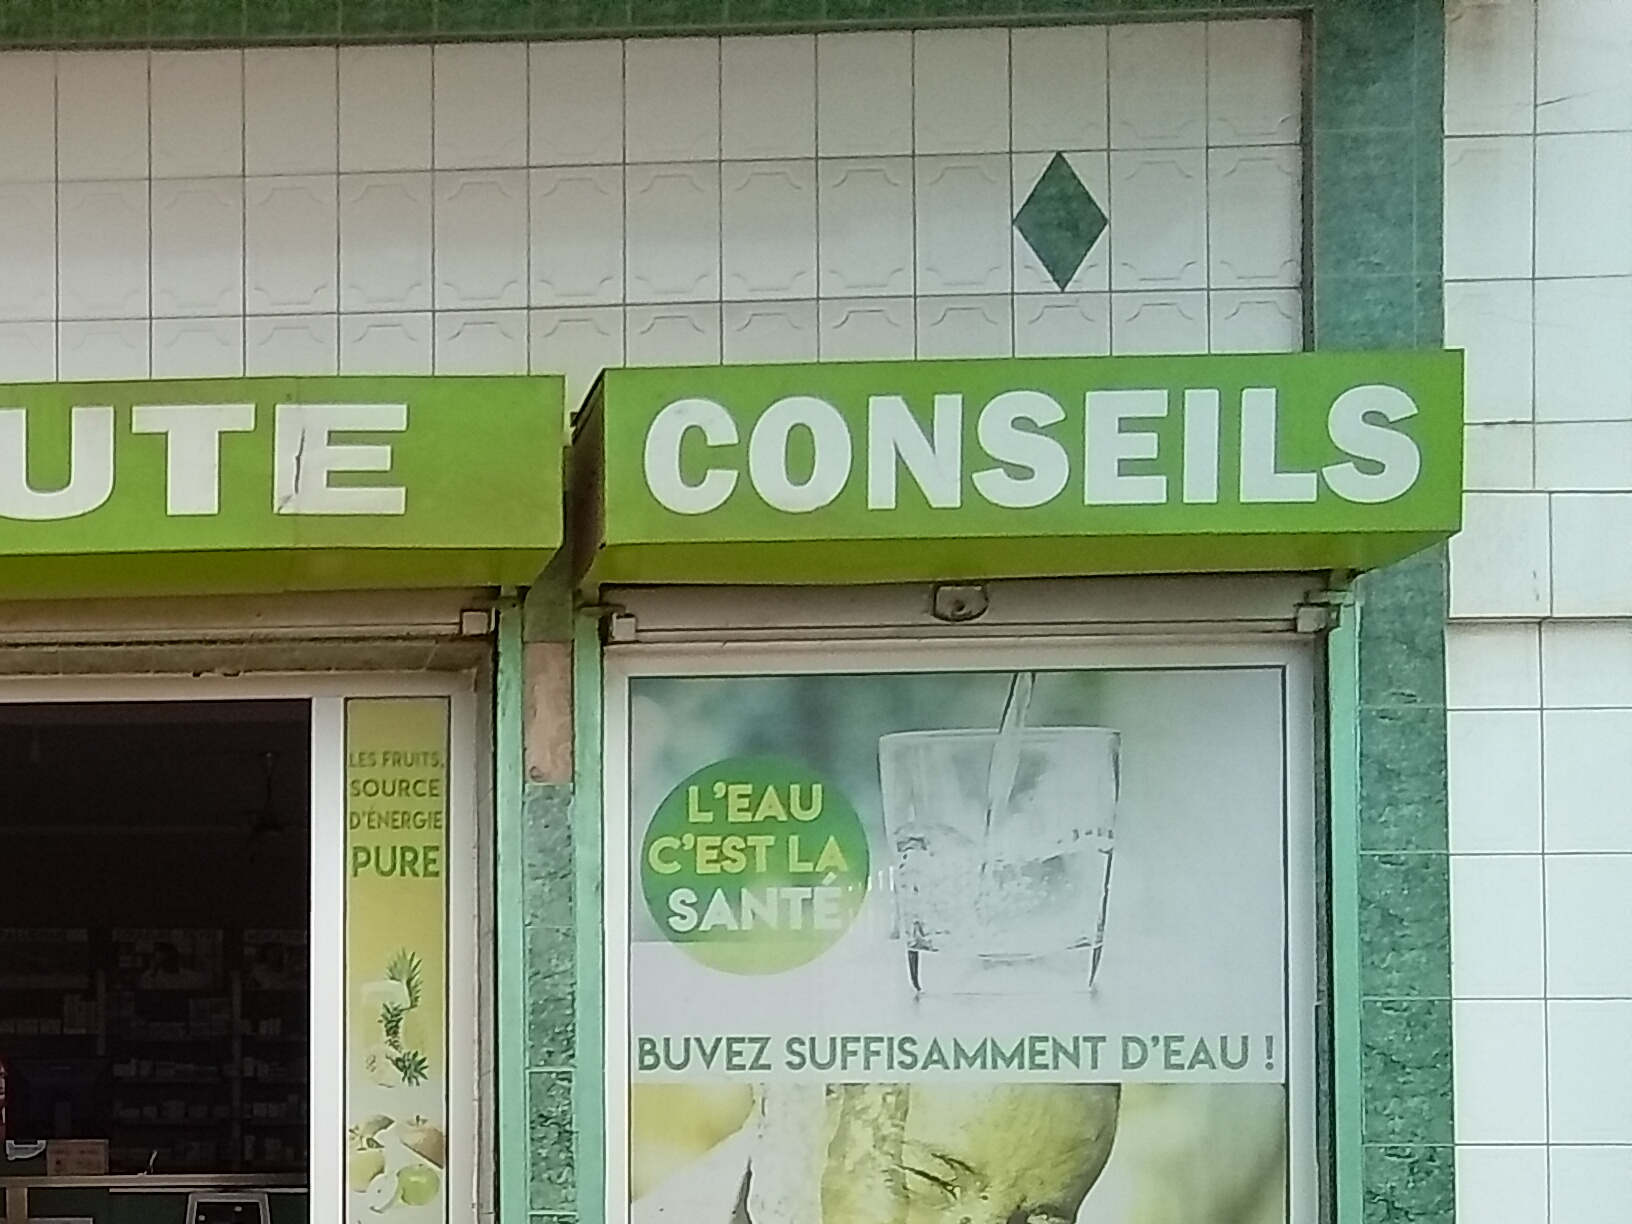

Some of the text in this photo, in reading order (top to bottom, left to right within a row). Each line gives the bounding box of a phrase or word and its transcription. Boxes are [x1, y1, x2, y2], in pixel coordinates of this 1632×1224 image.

[643, 384, 1422, 516] CONSEILS
[349, 751, 376, 768] LES
[350, 778, 441, 798] SOURCE
[688, 782, 822, 823] L'EAU
[349, 804, 443, 830] D'ÉNERGIE
[352, 845, 440, 878] PURE
[648, 833, 848, 875] C'EST LA
[668, 872, 843, 932] SANTÉ
[638, 1035, 772, 1072] BUVEZ
[784, 1035, 1107, 1072] SUFFISAMMENT
[1120, 1034, 1249, 1071] D'EAU
